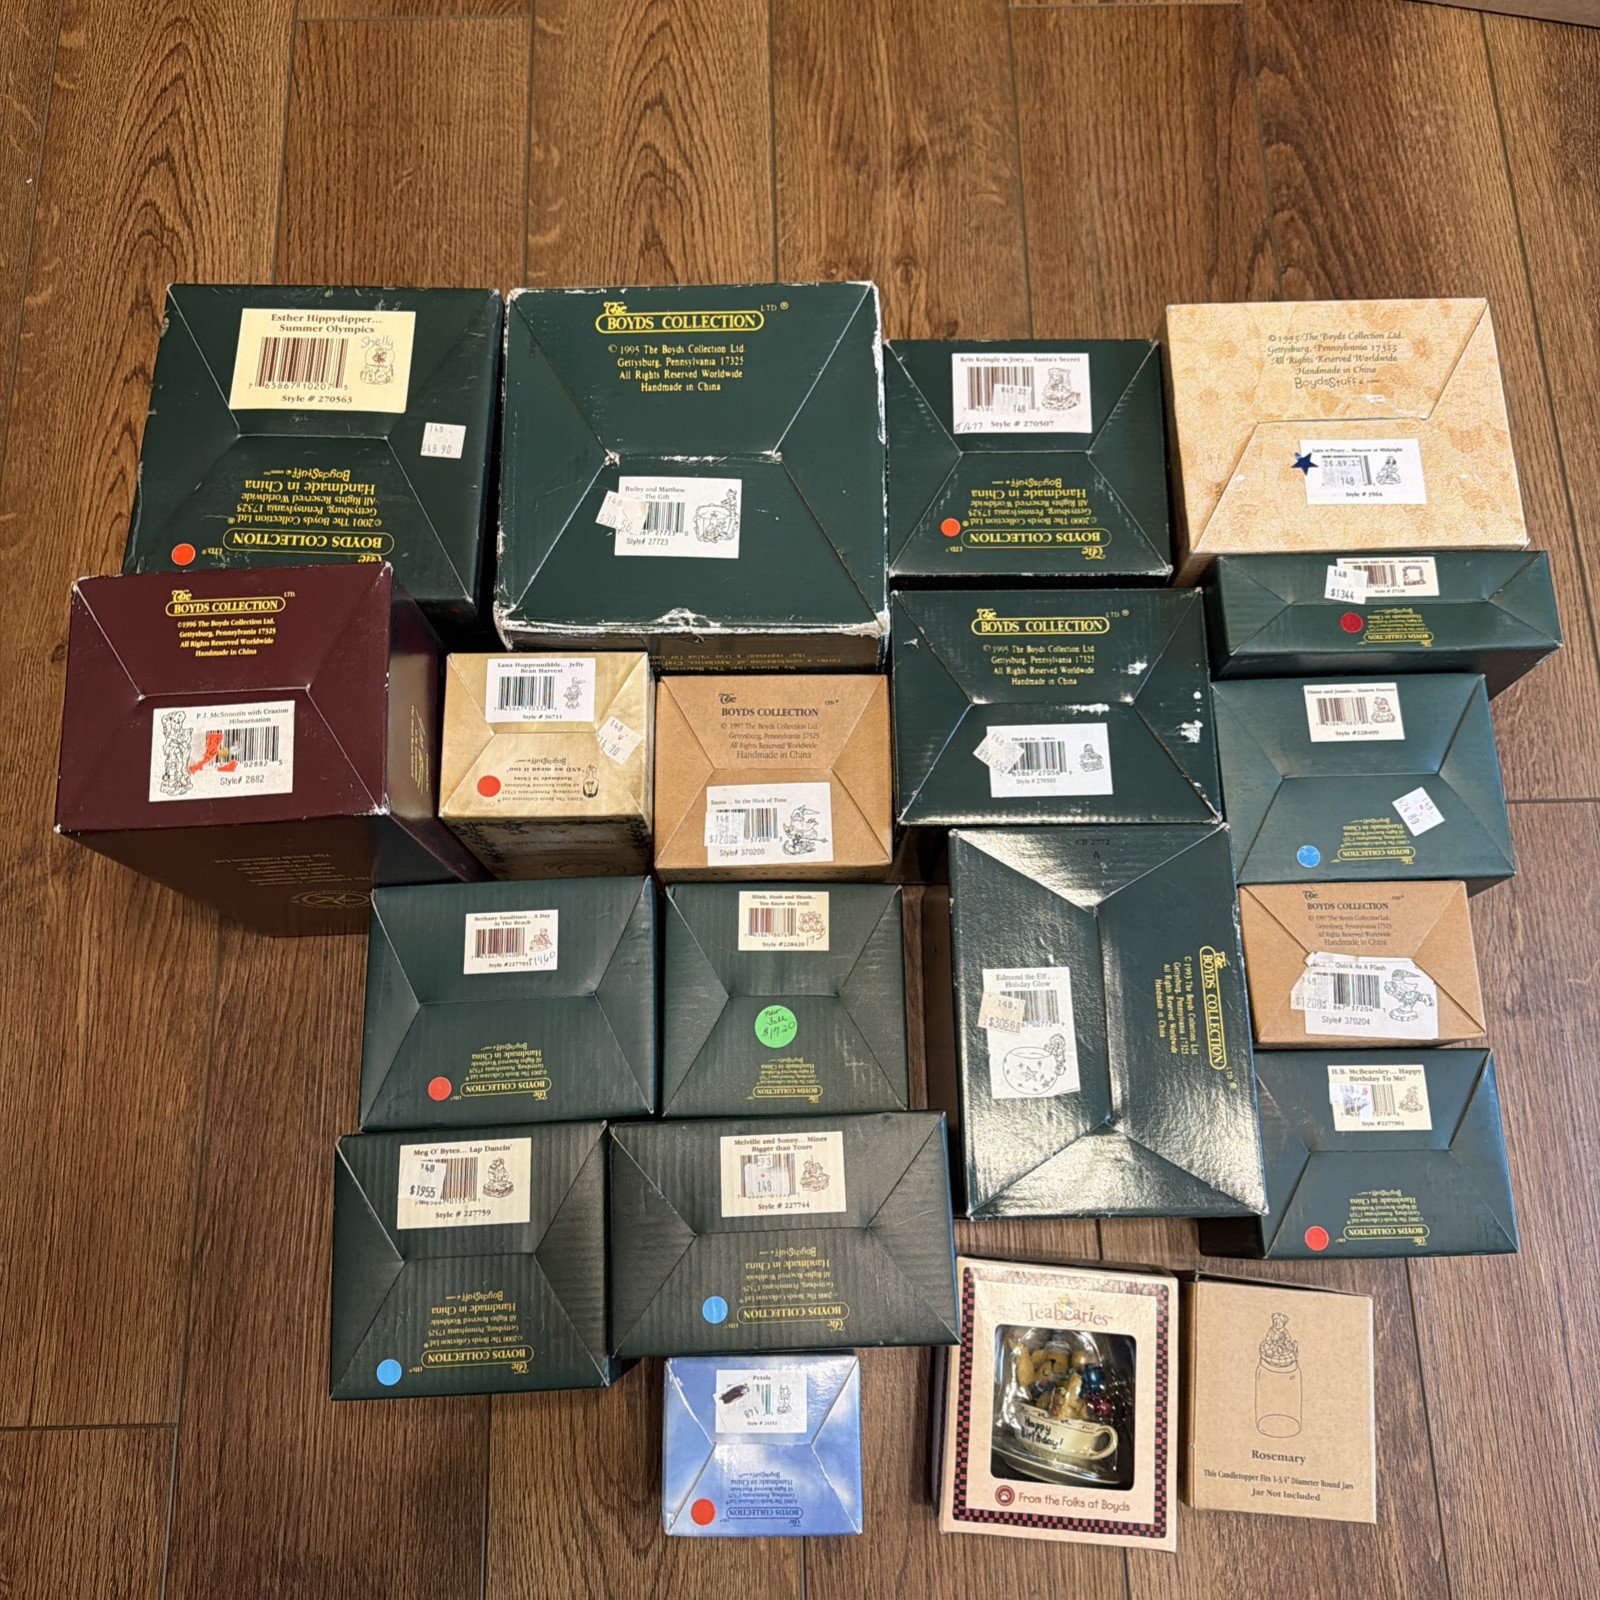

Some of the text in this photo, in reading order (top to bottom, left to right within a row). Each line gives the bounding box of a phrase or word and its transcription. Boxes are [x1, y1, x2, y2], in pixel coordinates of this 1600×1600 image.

[603, 302, 627, 315] The
[271, 314, 381, 323] Esther Hippydipper...
[607, 314, 755, 330] BOYDS COLLECTION
[279, 324, 374, 334] Summer Olympics
[1302, 333, 1318, 341] The
[1320, 333, 1345, 341] Boyds
[1349, 332, 1384, 340] Collection
[644, 345, 658, 354] The
[662, 345, 684, 355] Boyds
[688, 345, 726, 353] Collection
[666, 358, 715, 367] Pennsylvania
[721, 357, 744, 365] 17325
[1287, 356, 1313, 365] Rights
[620, 370, 743, 380] All Rights Reserved Worldwide
[1295, 367, 1340, 375] Handmade
[641, 382, 720, 392] Handmade in China
[282, 395, 304, 403] Style
[319, 396, 352, 404] 270563
[244, 480, 375, 494] Handmade in China
[971, 489, 1086, 499] Handmade in China
[237, 504, 262, 512] 17325
[267, 504, 323, 514] Pennsylvania
[233, 533, 382, 548] BOYDS COLLECTION
[626, 538, 645, 546] Style#
[970, 532, 1100, 542] BOYDS COLLECTION
[1082, 547, 1106, 560] The
[172, 590, 192, 602] The
[174, 600, 278, 614] BOYDS COLLECTION
[981, 620, 1102, 632] BOYDS COLLECTION
[721, 708, 819, 716] BOYDS COLLECTION
[220, 775, 265, 785] Style# 2882
[741, 848, 765, 856] 370200
[1322, 1016, 1370, 1026] Style# 370204
[758, 1203, 774, 1211] Style
[436, 1211, 454, 1219] Style
[1251, 1450, 1306, 1465] Rosemary
[1204, 1469, 1217, 1477] This
[1218, 1472, 1258, 1482] Candletopper
[1260, 1474, 1271, 1482] Fits
[1291, 1478, 1319, 1486] Diameter
[1321, 1480, 1340, 1488] Round
[1341, 1481, 1353, 1490] Jars
[1251, 1488, 1264, 1496] Jar
[1284, 1491, 1320, 1501] Included
[1019, 1492, 1130, 1513] From the Folks at Boyds
